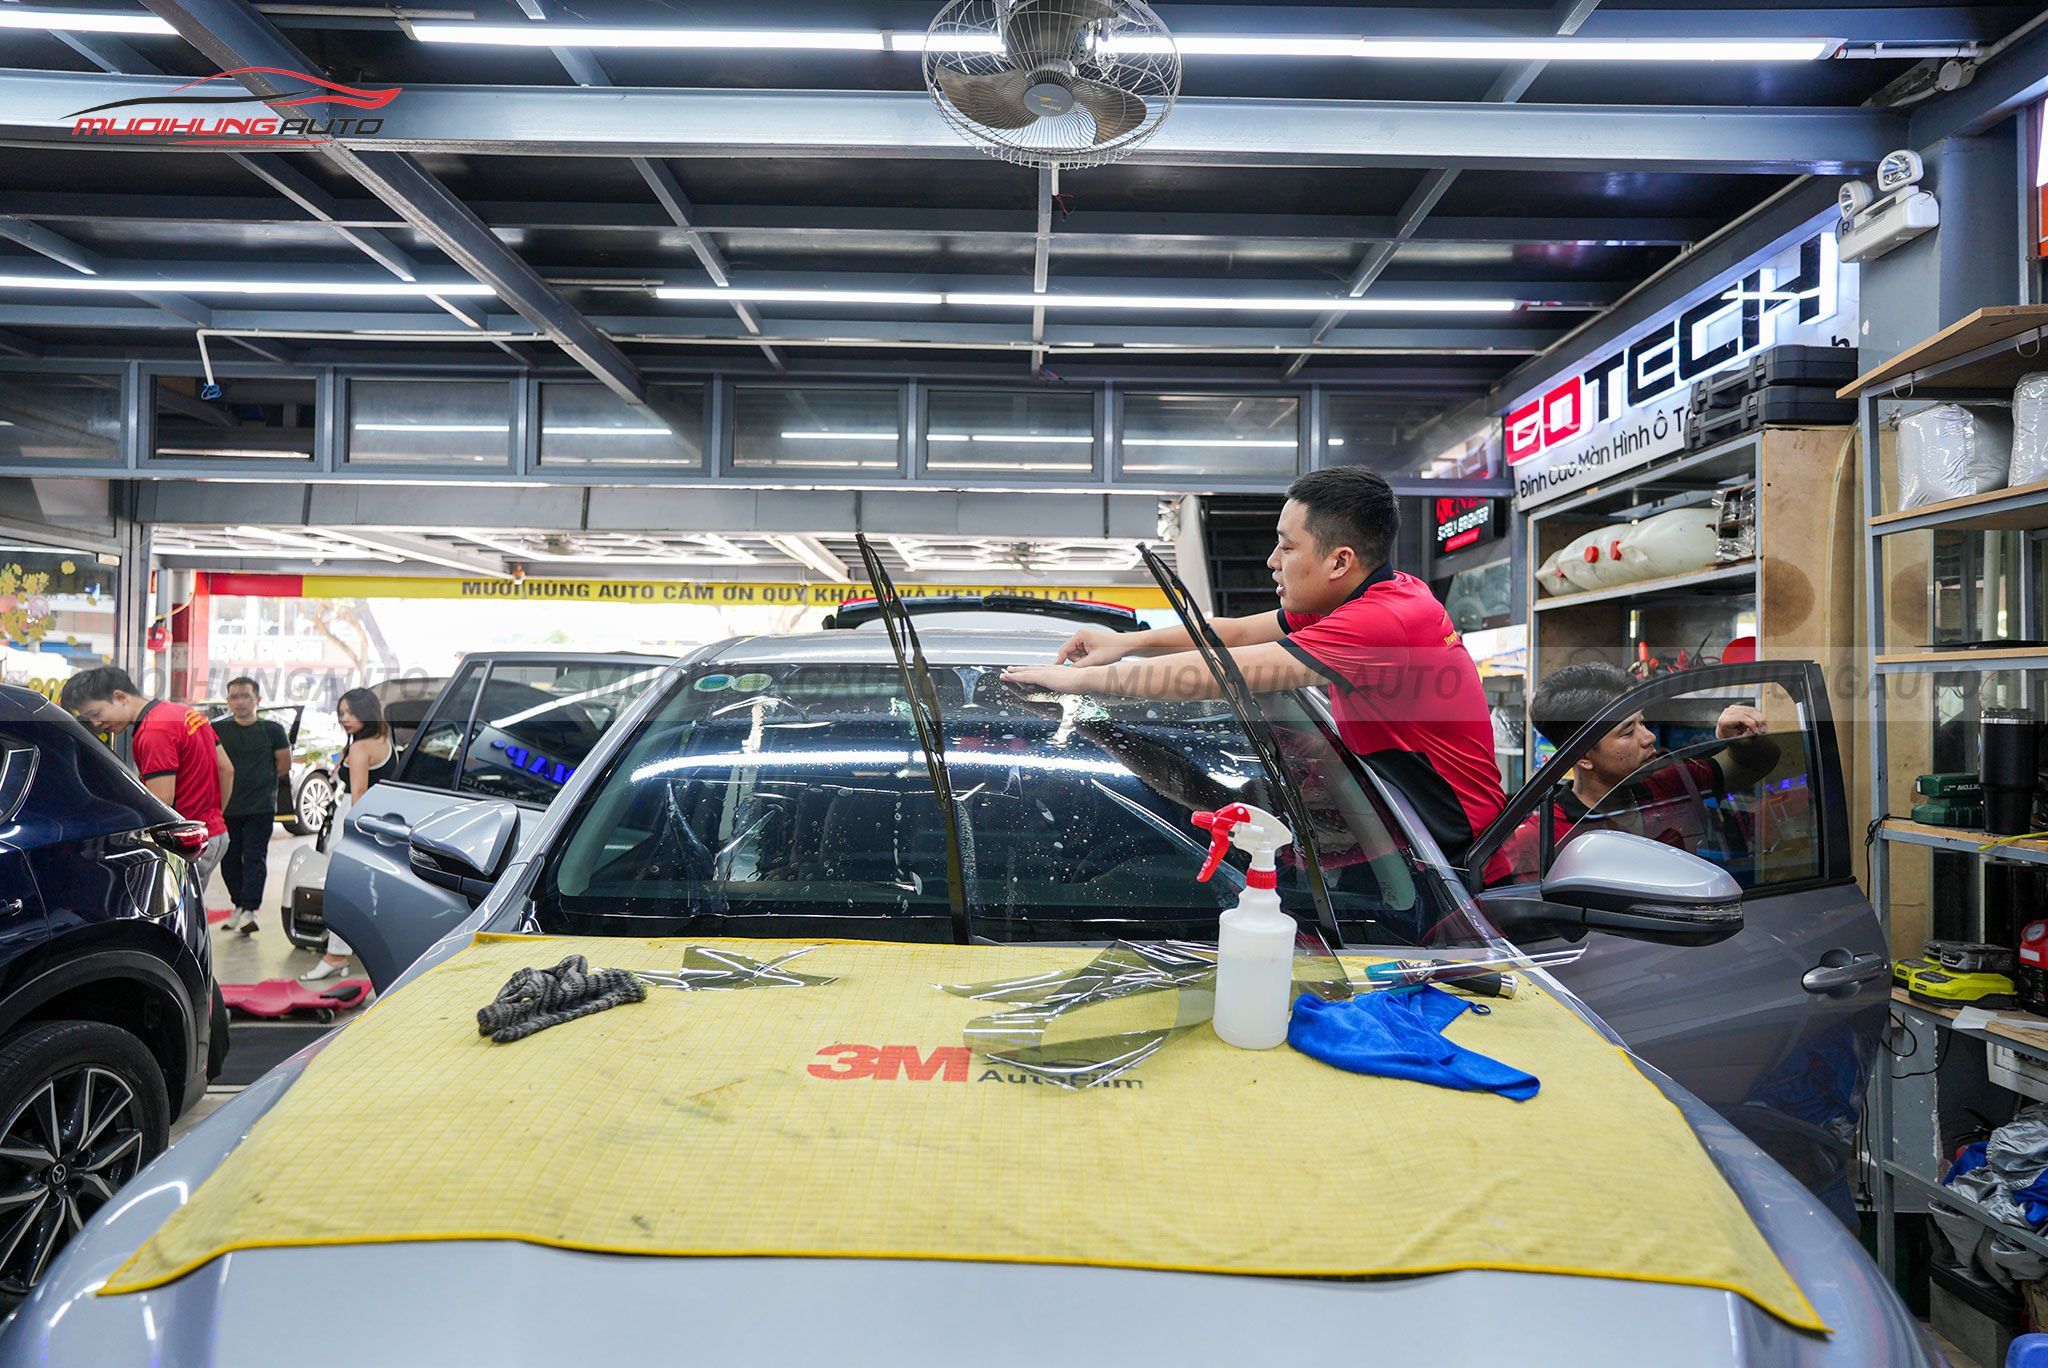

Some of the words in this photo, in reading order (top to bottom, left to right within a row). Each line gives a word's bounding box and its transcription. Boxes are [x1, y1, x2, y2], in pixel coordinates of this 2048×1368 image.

[1505, 232, 1838, 467] GOTECH
[1613, 425, 1650, 460] Hình
[599, 583, 655, 599] AUTO
[815, 585, 875, 602] KHÁC
[806, 1044, 972, 1082] 3M
